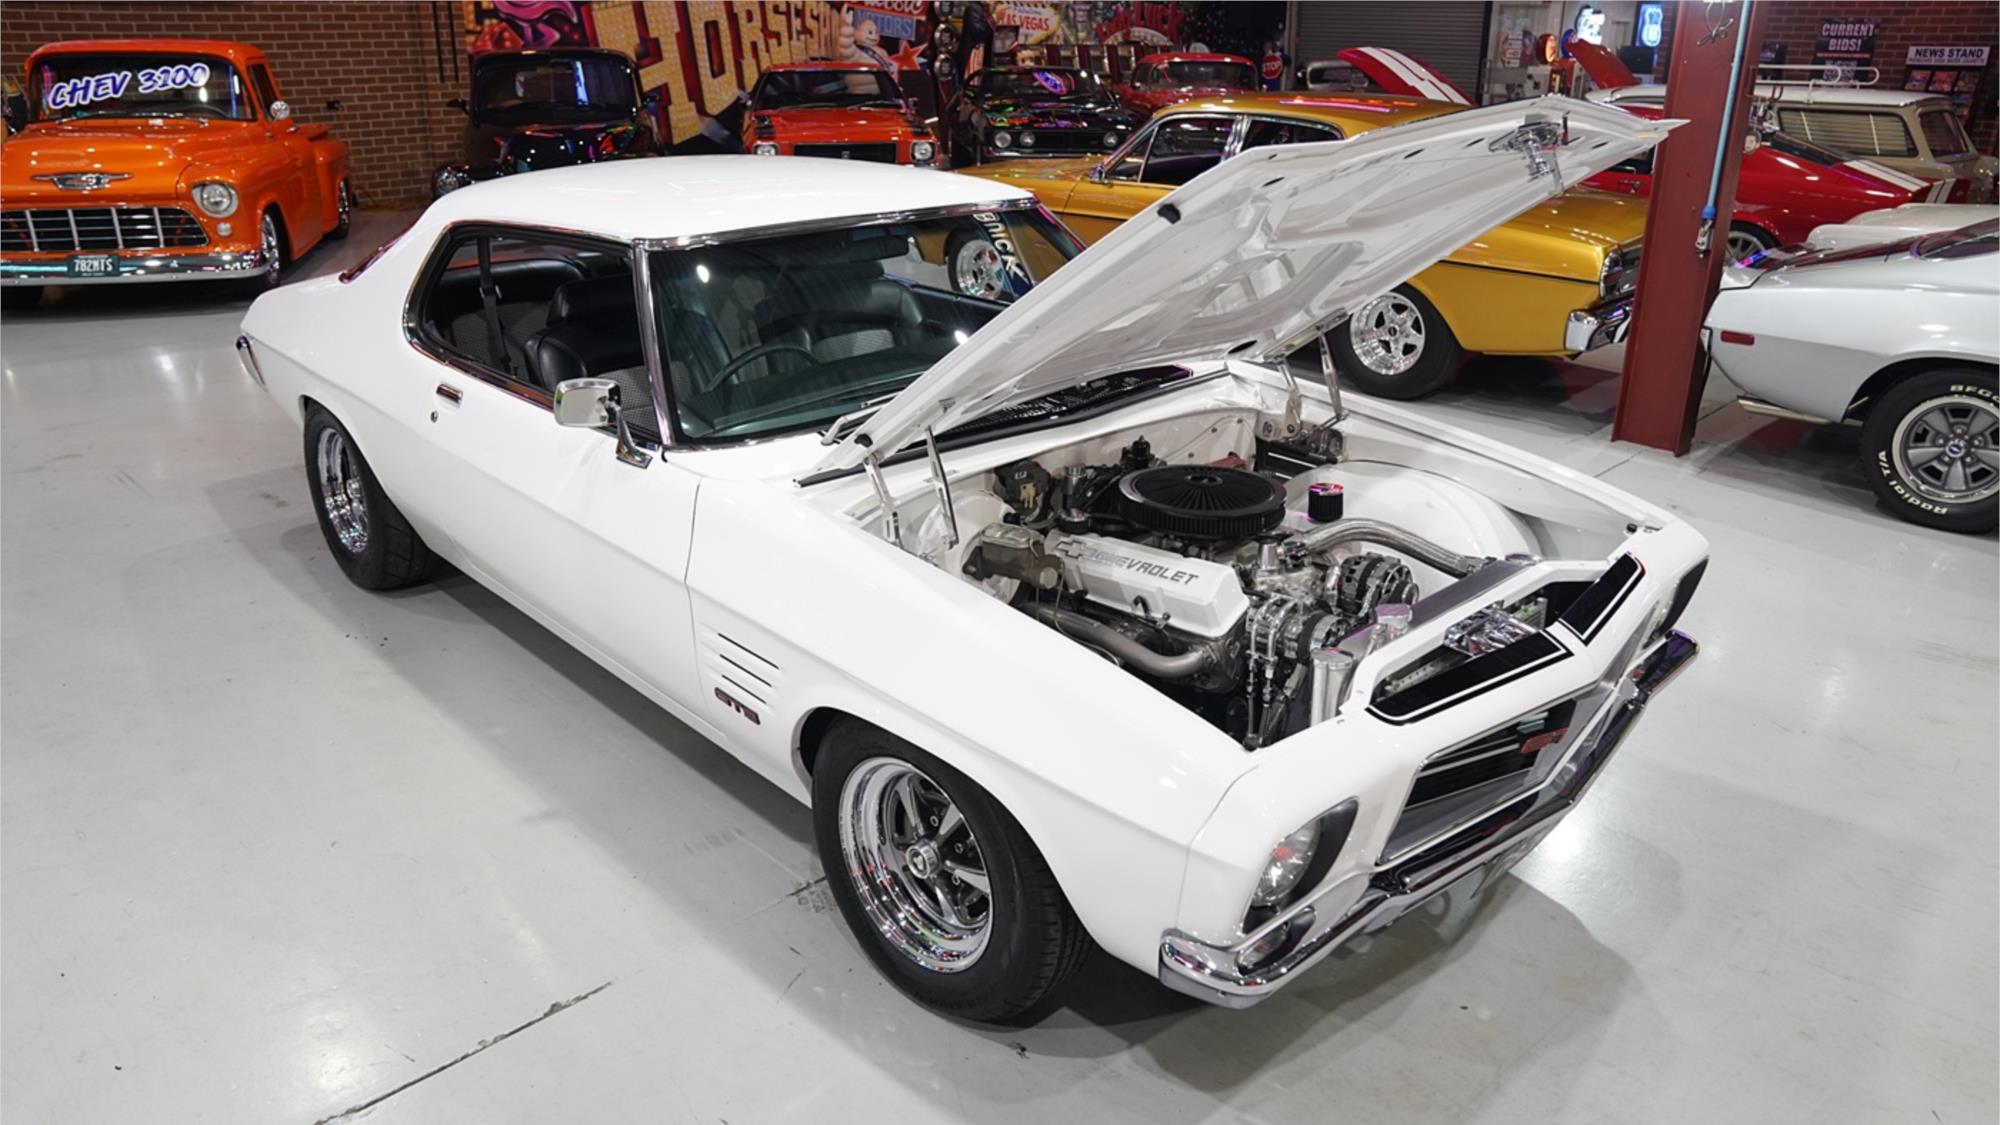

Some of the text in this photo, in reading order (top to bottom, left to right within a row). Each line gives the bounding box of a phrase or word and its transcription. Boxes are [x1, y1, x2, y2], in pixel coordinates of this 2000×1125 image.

[1019, 15, 1050, 31] VEGAS
[1822, 23, 1875, 36] CURRENT
[1828, 38, 1862, 51] BIDS!
[1914, 48, 1984, 58] NEWS STAND
[1262, 60, 1282, 72] STOP
[50, 63, 210, 110] CHEV 3100
[1877, 450, 1948, 514] Radial T/A
